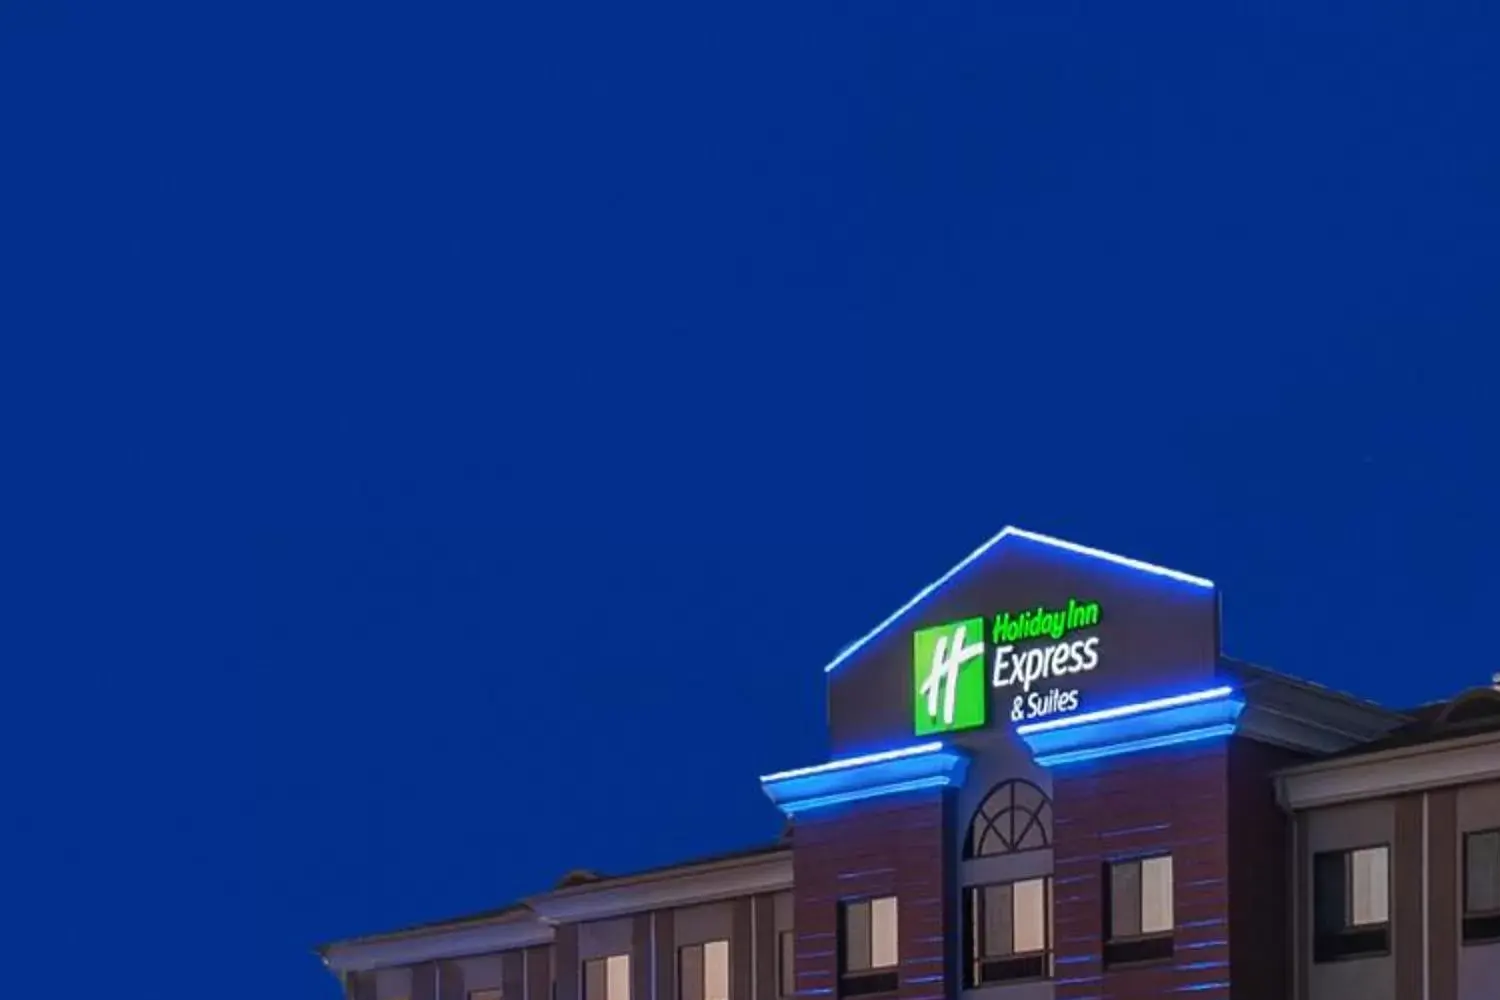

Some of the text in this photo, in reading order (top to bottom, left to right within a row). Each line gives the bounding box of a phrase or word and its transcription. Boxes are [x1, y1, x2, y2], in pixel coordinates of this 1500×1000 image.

[992, 599, 1099, 643] Holiday Inn
[992, 637, 1100, 692] Express
[1011, 688, 1079, 721] & Suites
